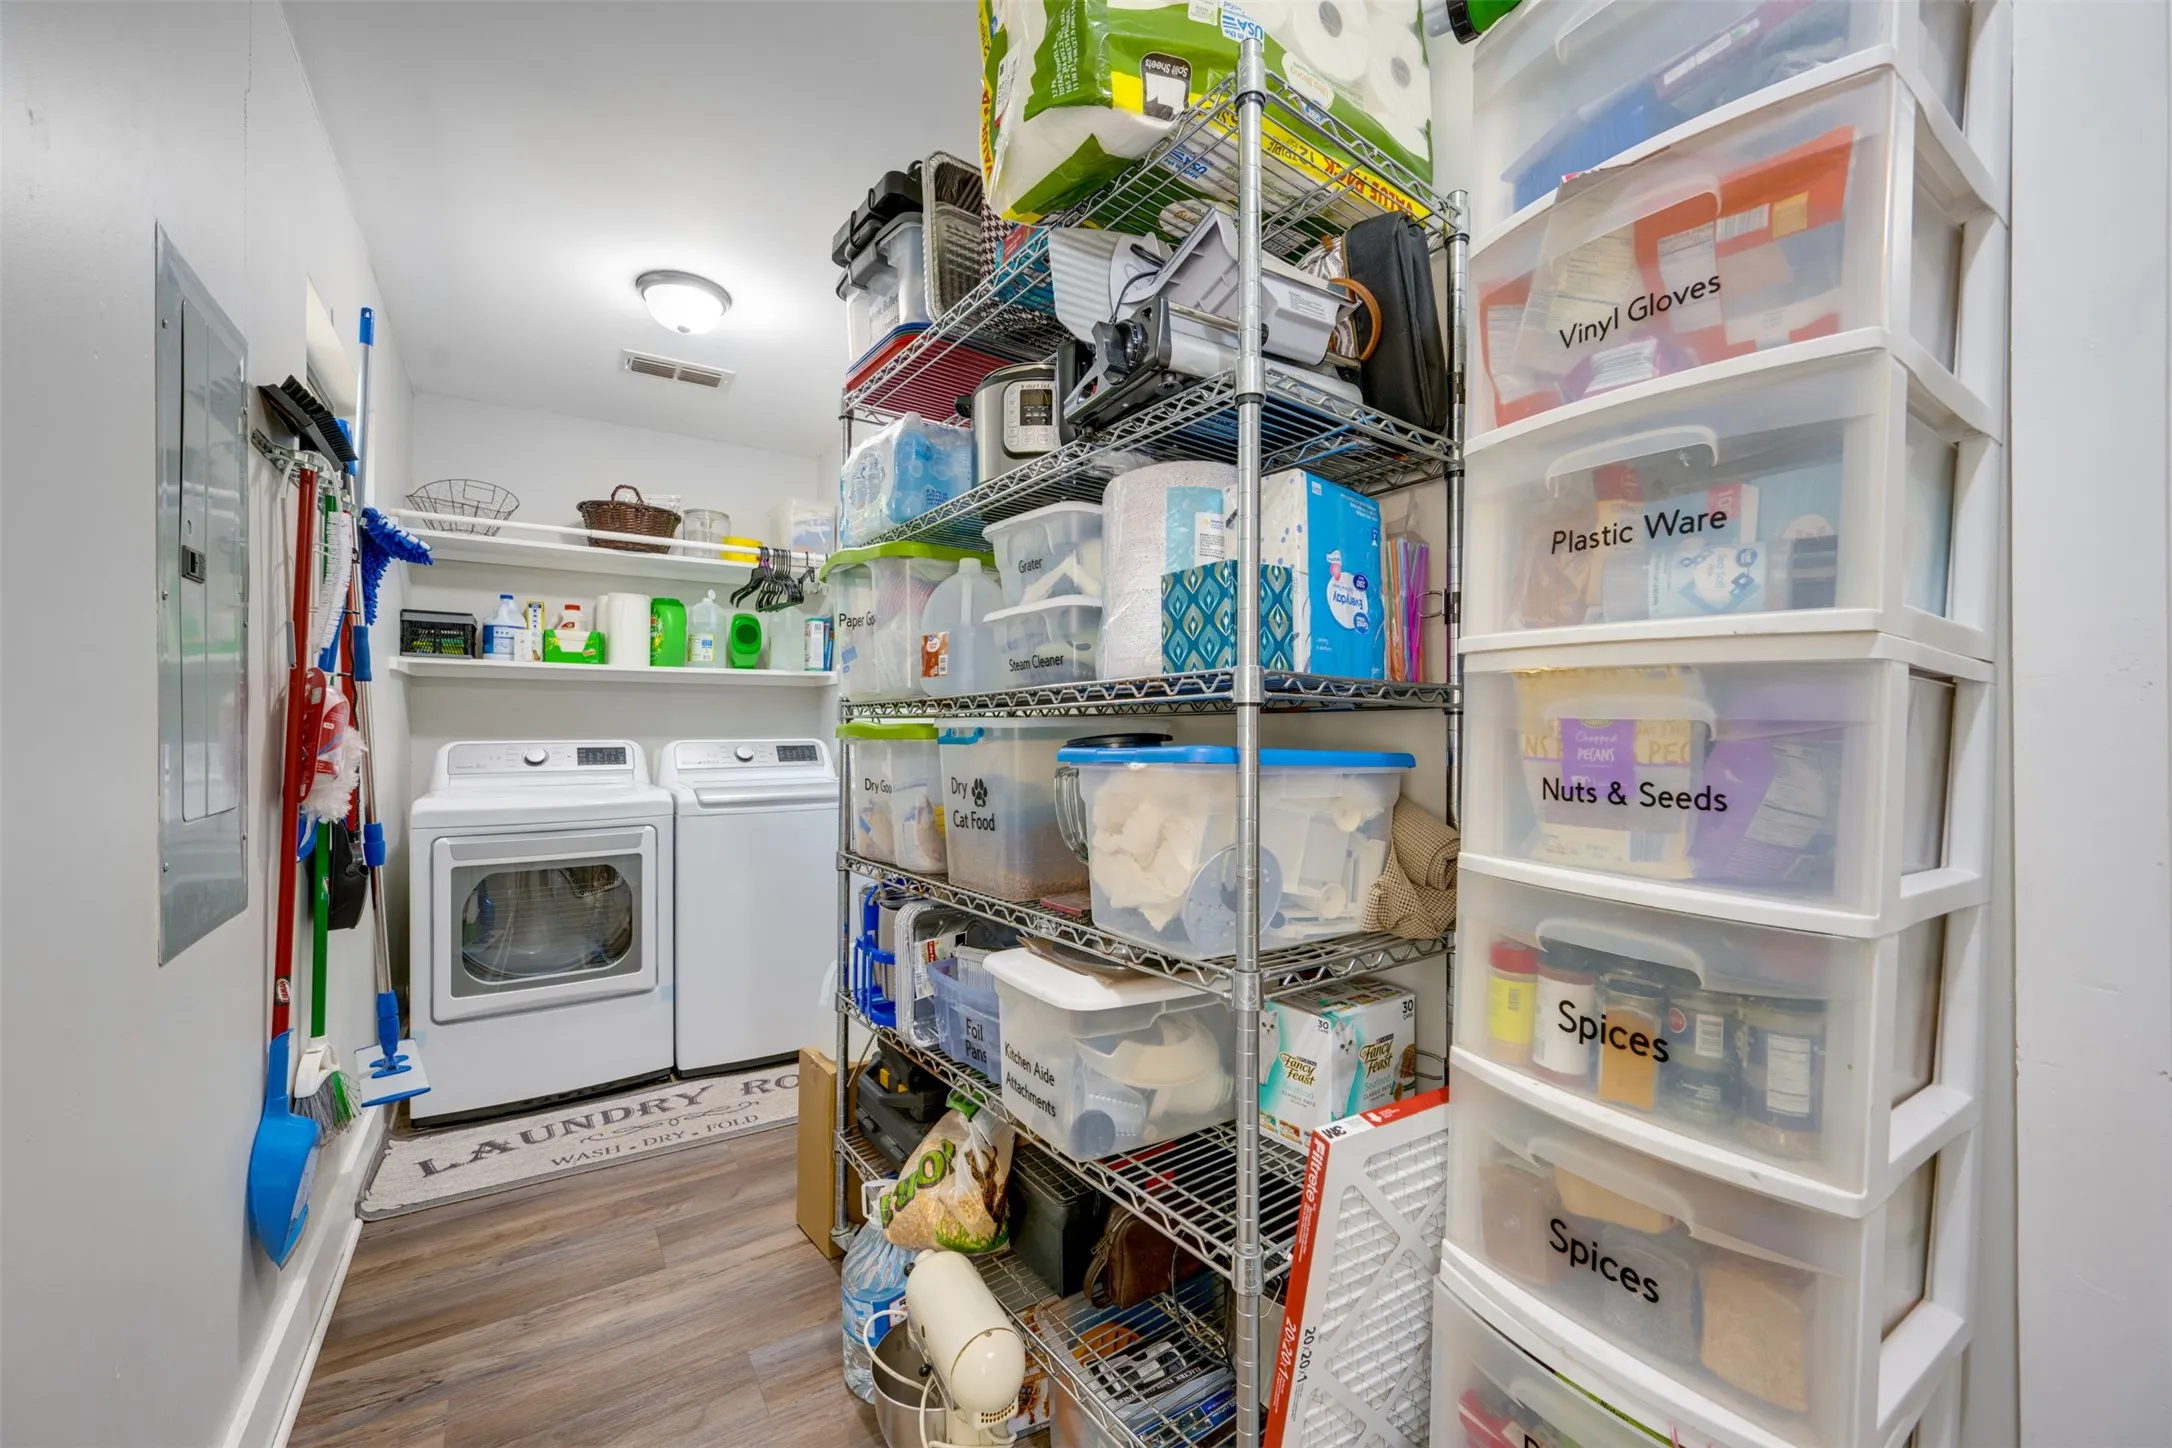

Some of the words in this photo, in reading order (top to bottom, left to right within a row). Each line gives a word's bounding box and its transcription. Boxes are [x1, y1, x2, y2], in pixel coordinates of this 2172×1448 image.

[1224, 28, 1237, 39] the
[1237, 18, 1264, 40] USA
[1144, 58, 1172, 74] Sheets
[1171, 64, 1189, 77] Split
[1368, 180, 1417, 221] VALUE
[1558, 307, 1620, 348] Vinyl
[1627, 273, 1722, 323] Gloves
[1550, 522, 1634, 554] Plastic
[1644, 508, 1728, 539] Ware
[1018, 557, 1043, 574] Grater
[1333, 591, 1364, 610] Everyday
[838, 611, 865, 630] Paper
[1008, 655, 1030, 672] Steam
[1031, 652, 1064, 669] Cleaner
[1574, 730, 1618, 743] Chopped
[1577, 747, 1615, 763] PECANS
[864, 778, 879, 794] Dry
[950, 777, 968, 799] Dry
[1542, 777, 1598, 804] Nuts
[1606, 781, 1628, 806] &
[1639, 782, 1728, 812] Seeds
[952, 810, 970, 830] Cat
[970, 811, 996, 832] Food
[1402, 999, 1414, 1014] 30
[966, 1018, 983, 1042] Foil
[1317, 1019, 1329, 1030] 30
[1557, 1000, 1670, 1064] Spices
[966, 1039, 987, 1064] Pans
[1360, 1041, 1393, 1062] Fancy
[1004, 1041, 1032, 1073] Kitchen
[1033, 1062, 1056, 1087] Aide
[1280, 1053, 1316, 1076] Fancy
[1366, 1053, 1393, 1079] Feast
[1287, 1067, 1316, 1086] Feast
[1005, 1071, 1057, 1118] Attachments
[415, 1084, 715, 1178] LAUNDRY
[551, 1144, 622, 1167] WASH
[643, 1130, 687, 1147] DRY
[706, 1114, 760, 1134] FOLD
[1322, 1125, 1347, 1140] 3M
[1304, 1136, 1327, 1202] Filtrete
[1548, 1218, 1660, 1305] Spices
[1277, 1315, 1297, 1381] 20x20x1
[1295, 1326, 1317, 1384] 20x20x1
